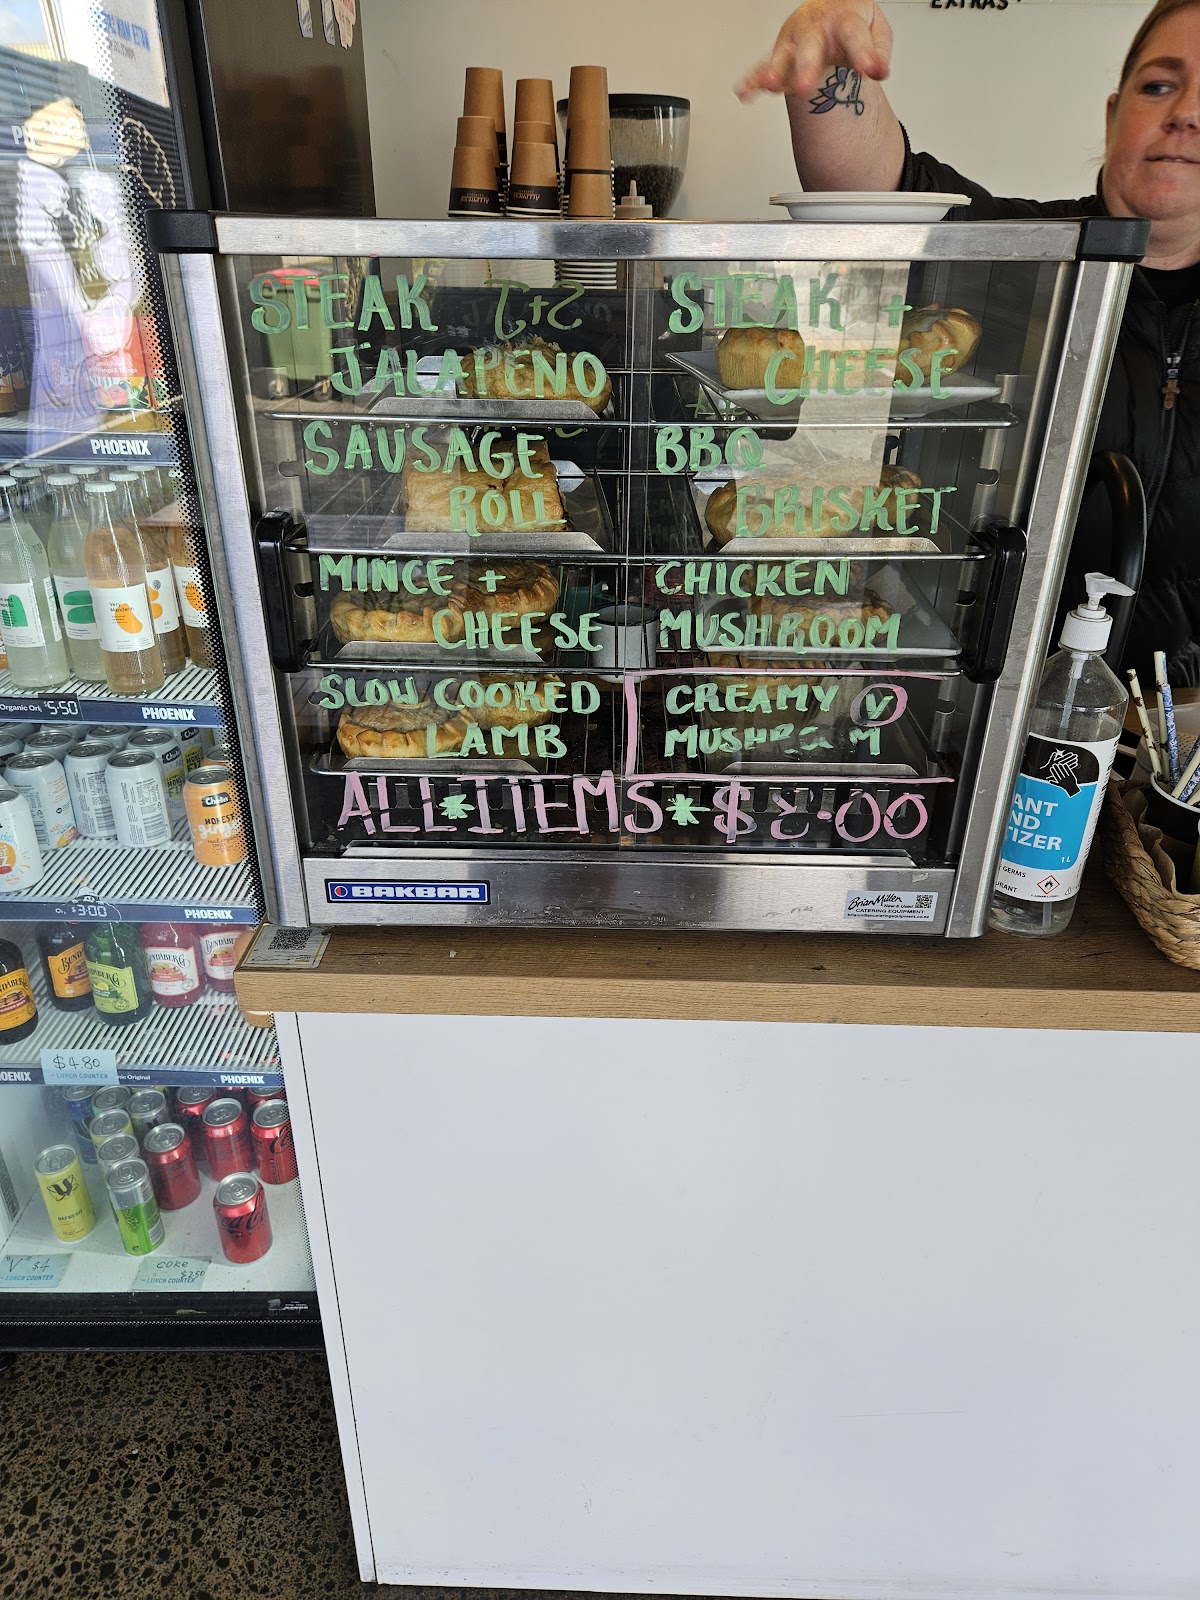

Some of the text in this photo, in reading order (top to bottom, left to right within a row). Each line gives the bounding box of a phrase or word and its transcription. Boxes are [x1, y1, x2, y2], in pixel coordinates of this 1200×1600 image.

[249, 273, 439, 335] STEAK
[667, 271, 913, 335] STEAK +
[327, 341, 607, 399] JALAPENO
[763, 345, 960, 406] CHEESE
[90, 439, 152, 456] PHOENIX
[303, 420, 545, 480] SAUSAGE
[655, 425, 768, 474] BBQ
[449, 485, 568, 537] ROLL
[734, 483, 958, 538] BRISKET
[318, 554, 507, 596] MINCE +
[655, 558, 850, 598] CHICKEN
[431, 608, 604, 652] CHEESE
[659, 608, 901, 655] MUSHROOM
[0, 704, 28, 712] Organic
[142, 706, 196, 720] PHOENIX
[318, 673, 601, 715] SLOW COOKED
[665, 684, 840, 715] CREAMY
[426, 722, 568, 759] LAMB
[664, 723, 881, 759] MUSHRM
[337, 771, 457, 835] ALL
[457, 770, 664, 835] ITEMS
[1008, 826, 1063, 851] IZER
[1002, 865, 1027, 878] GERMS
[351, 886, 480, 899] BAKBAR
[184, 909, 233, 919] PHOENIX
[0, 1071, 31, 1081] OENIX
[53, 1054, 101, 1070] $4.80
[221, 1075, 265, 1084] PHOENIX
[32, 1258, 50, 1272] $4
